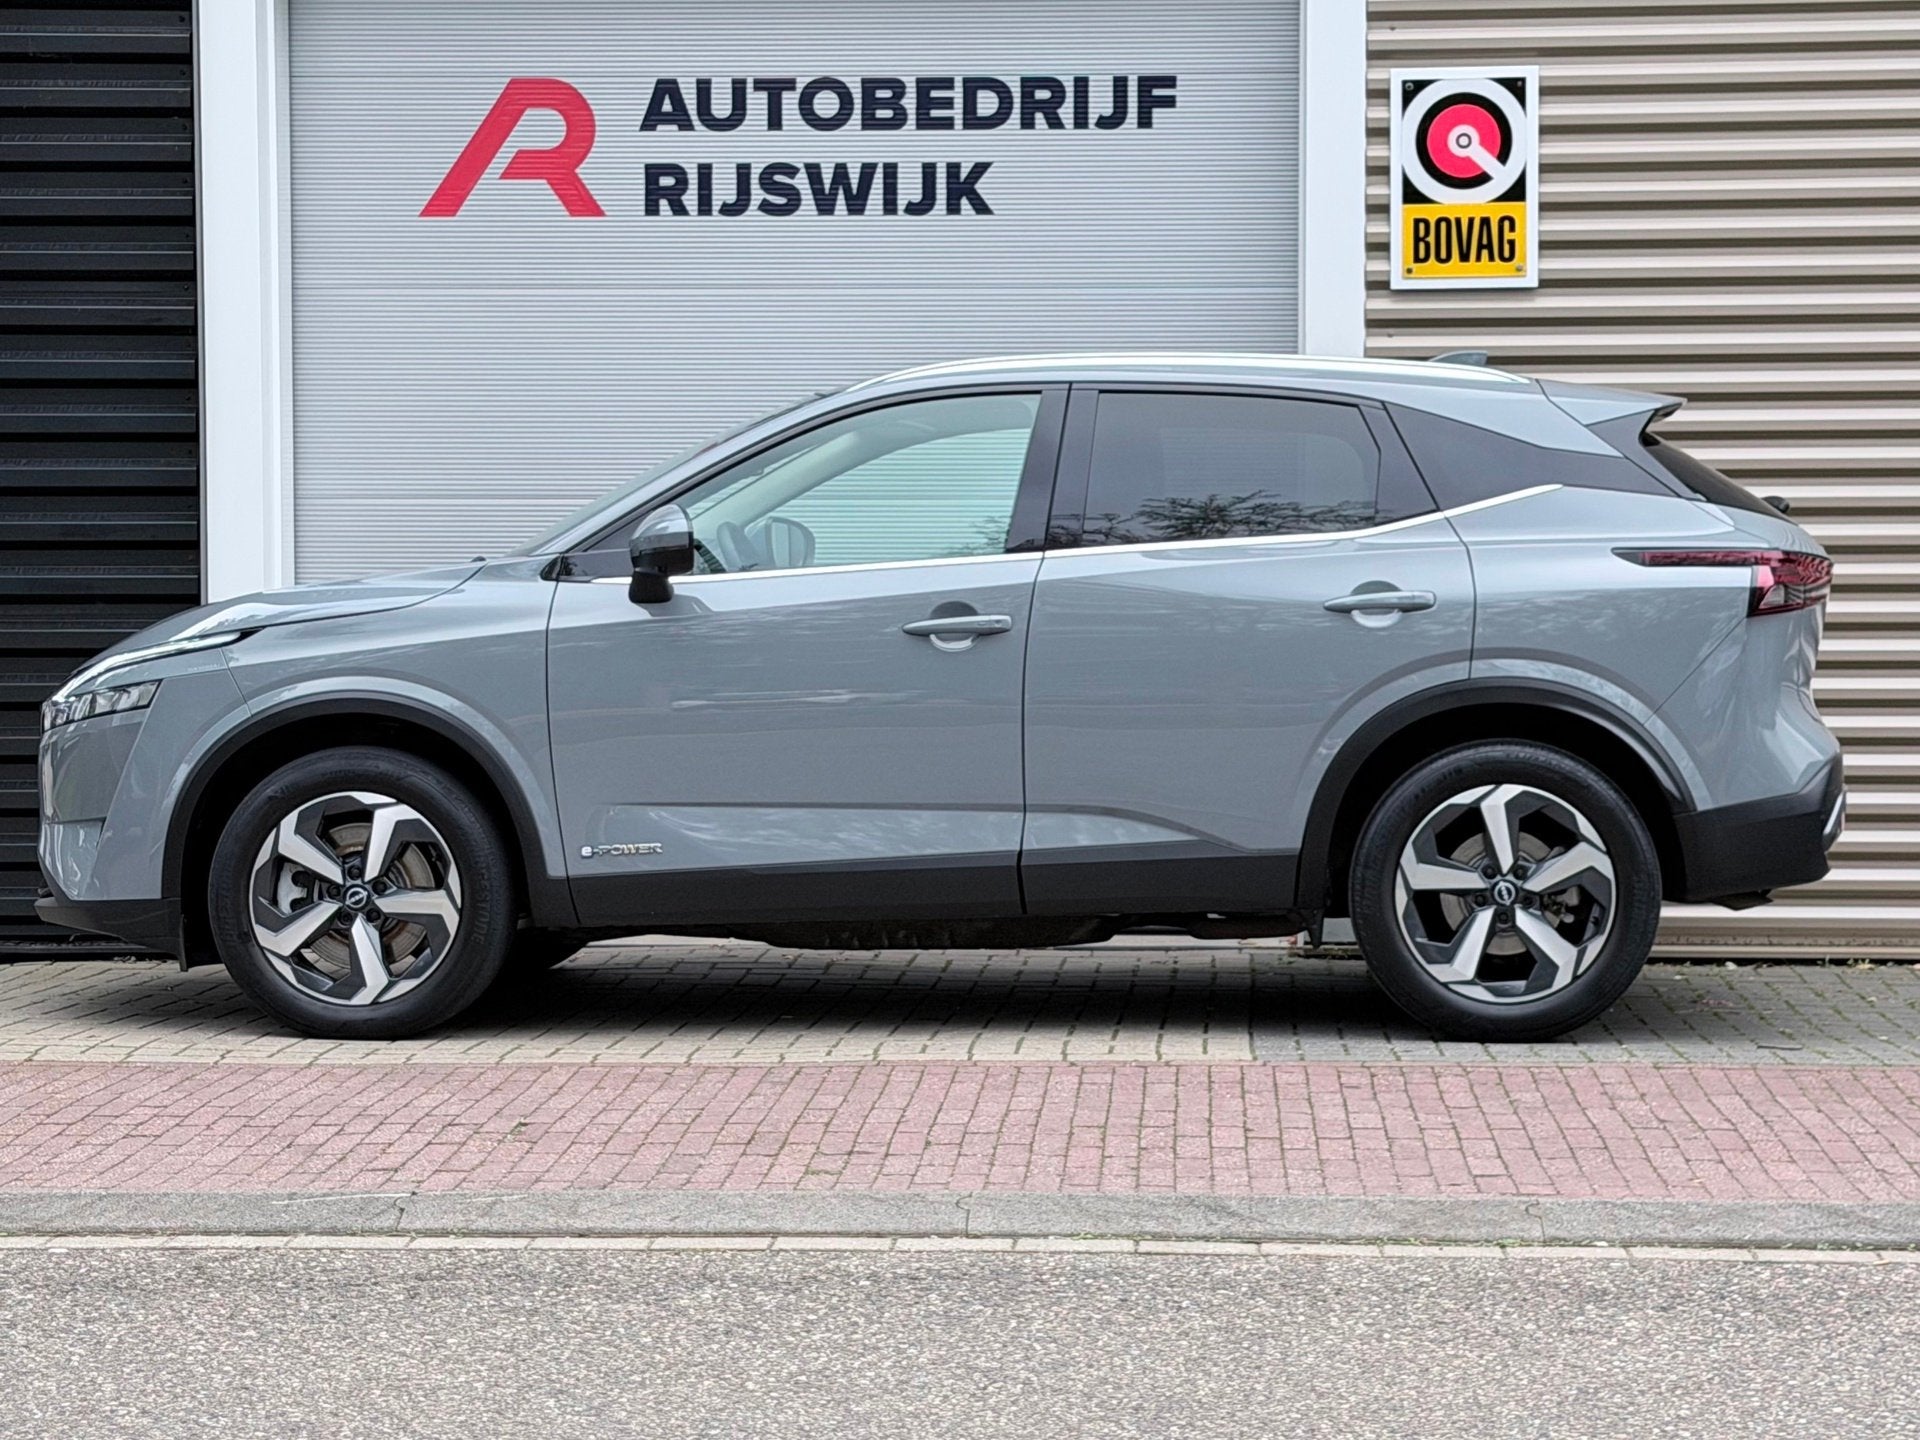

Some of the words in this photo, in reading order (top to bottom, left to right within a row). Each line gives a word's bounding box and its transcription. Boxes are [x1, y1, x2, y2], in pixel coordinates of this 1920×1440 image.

[639, 75, 1178, 132] AUTOBEDRIJF
[643, 161, 994, 217] RIJSWIJK
[1412, 215, 1516, 264] BOVAG
